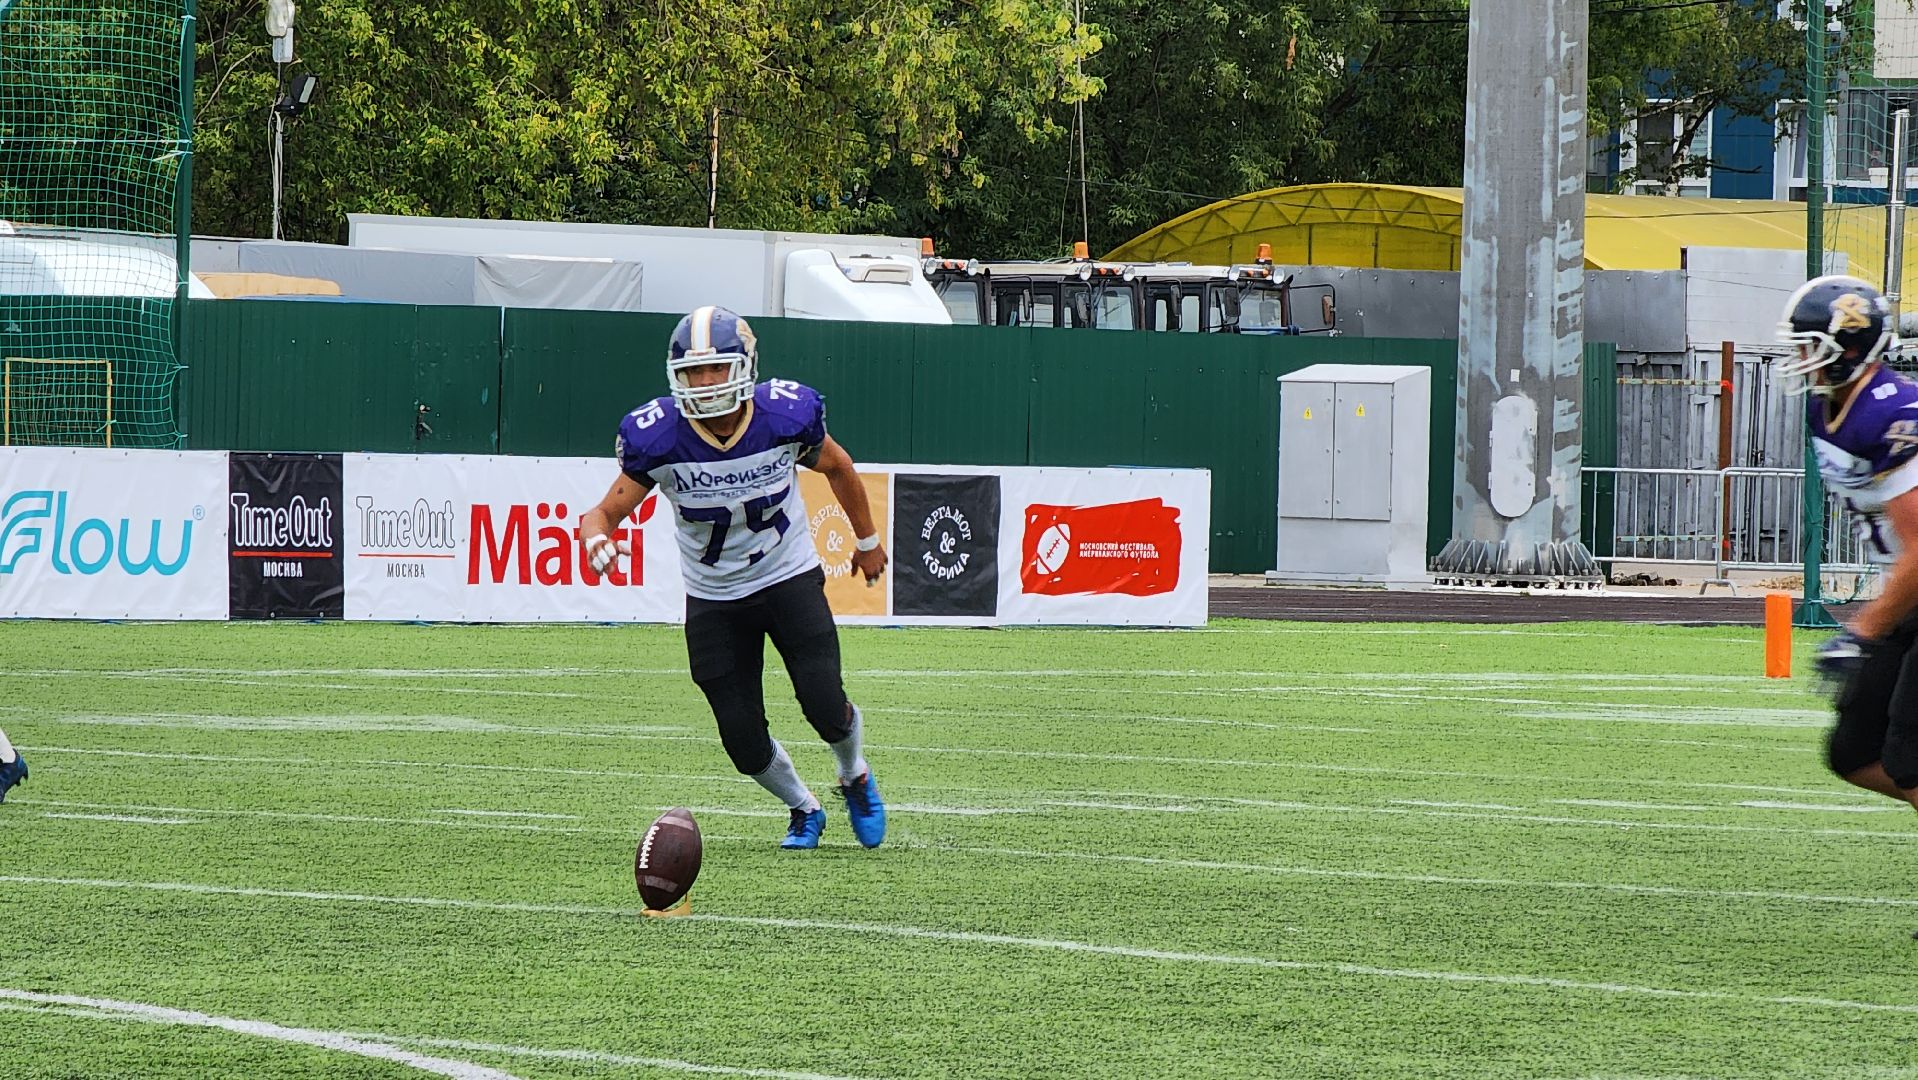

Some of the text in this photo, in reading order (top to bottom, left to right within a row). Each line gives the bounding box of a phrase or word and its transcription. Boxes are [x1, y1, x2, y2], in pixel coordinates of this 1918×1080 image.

[770, 377, 800, 400] 75
[631, 399, 666, 430] 75
[0, 490, 194, 576] Flow
[678, 484, 791, 567] 75
[921, 505, 972, 541] БЕРГАМОТ
[826, 530, 844, 552] &
[939, 531, 956, 554] &
[1079, 541, 1155, 551] МОСКОВСКИЙ ФЕСТИВАЛЬ
[1079, 550, 1160, 559] АМЕРИКАНСКОГО ФУТБОЛА
[263, 561, 303, 577] МОСКВА
[386, 562, 426, 578] МОСКВА
